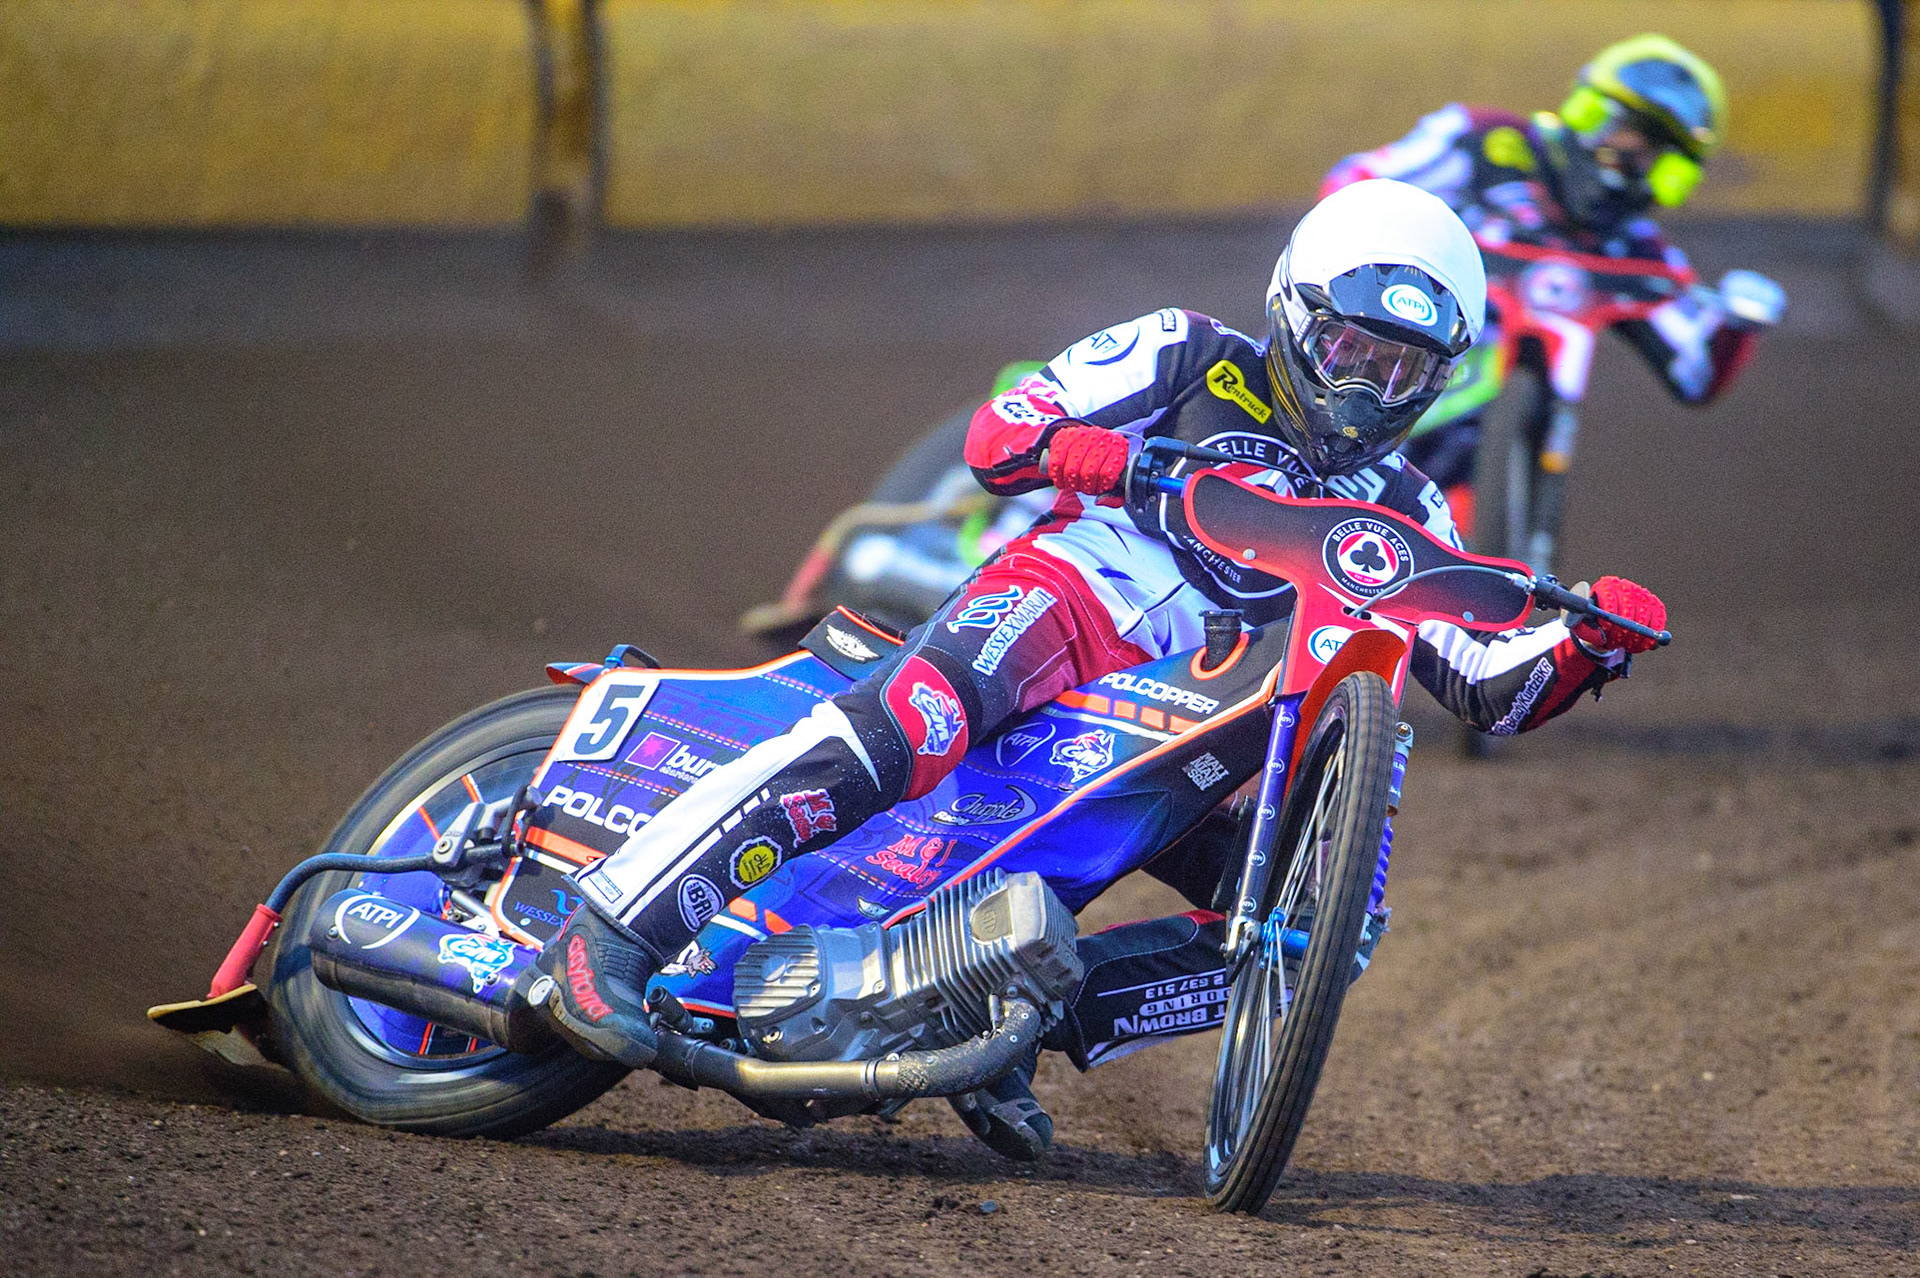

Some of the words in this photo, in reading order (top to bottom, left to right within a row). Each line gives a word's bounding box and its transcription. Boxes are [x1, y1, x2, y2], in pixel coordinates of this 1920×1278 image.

[1396, 296, 1425, 314] ATPI
[1090, 331, 1121, 354] ATI
[1213, 366, 1267, 418] Rentruck
[1217, 440, 1266, 458] ELLE
[1332, 522, 1362, 542] BELLE
[1366, 523, 1389, 537] VUE
[1390, 537, 1409, 562] ACES
[1183, 535, 1241, 583] ANCHESTER
[1098, 672, 1220, 715] POLCOPPER
[573, 684, 646, 756] 5
[887, 833, 927, 857] M
[920, 837, 944, 863] &
[935, 839, 958, 868] J
[348, 902, 404, 929] ATPI
[1145, 983, 1175, 999] 513
[1113, 1007, 1207, 1036] BROWN
